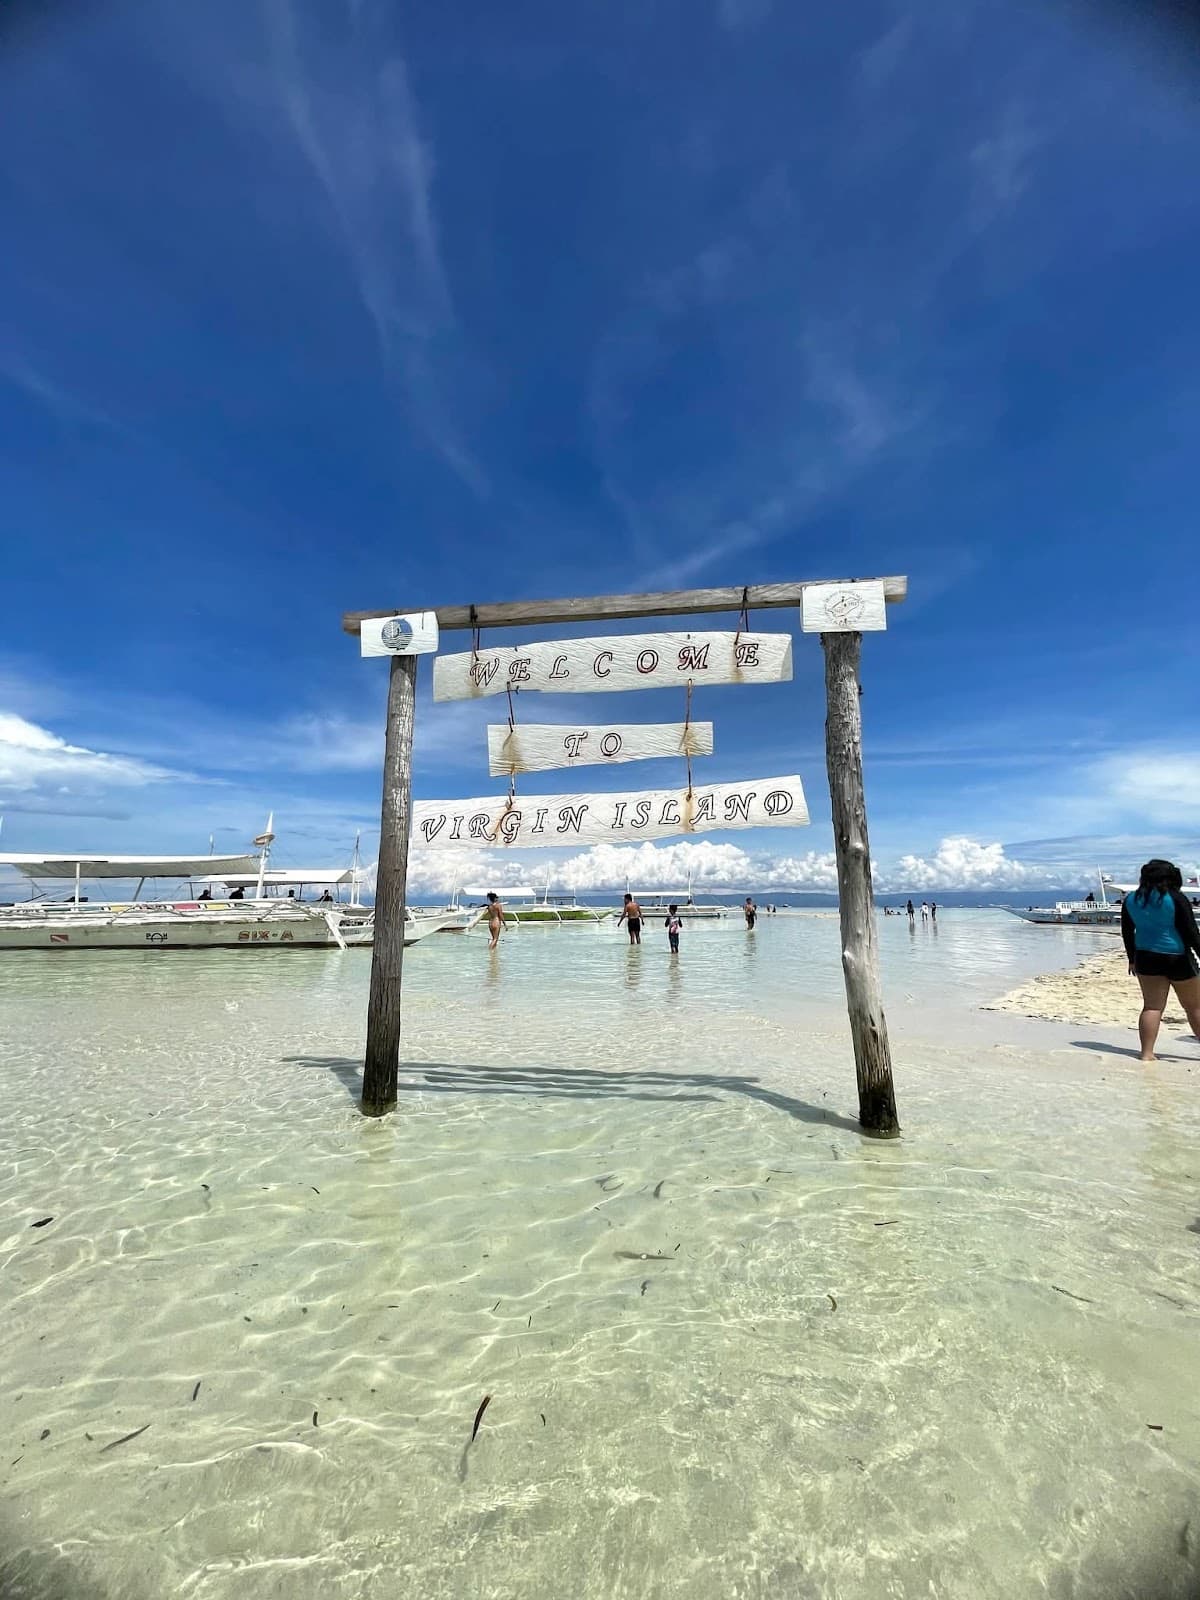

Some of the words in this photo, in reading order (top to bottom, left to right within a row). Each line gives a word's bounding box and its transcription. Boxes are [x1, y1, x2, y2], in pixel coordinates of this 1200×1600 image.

[470, 643, 759, 687] WELCOME
[564, 732, 622, 757] TO
[420, 804, 588, 843] VIRGIN
[611, 791, 793, 829] ISLAND
